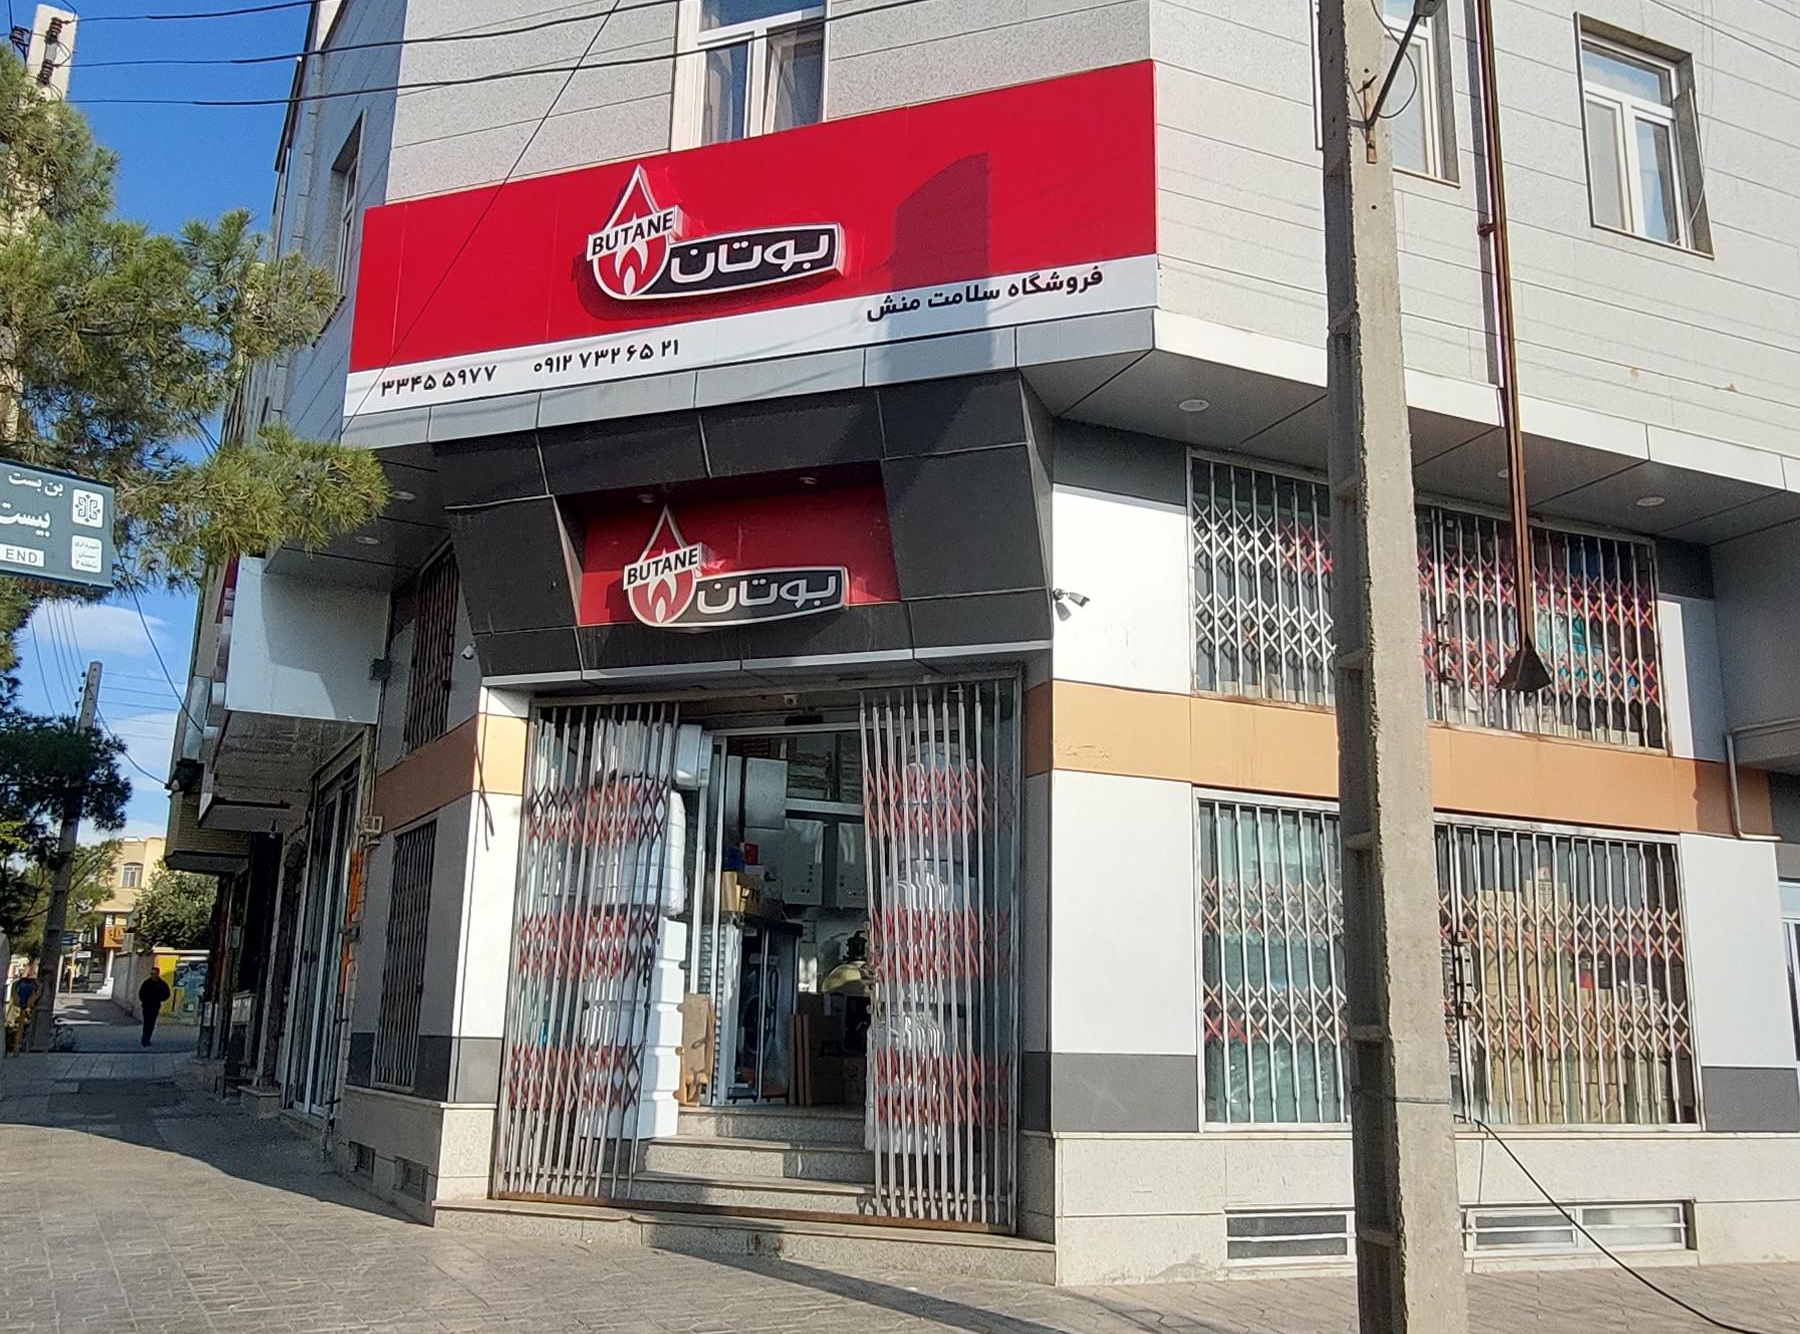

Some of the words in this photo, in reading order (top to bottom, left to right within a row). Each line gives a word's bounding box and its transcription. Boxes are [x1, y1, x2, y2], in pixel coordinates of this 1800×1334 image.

[591, 211, 674, 256] BUTANE
[669, 234, 830, 284] بوتان
[927, 283, 1001, 309] سلامت
[1007, 265, 1104, 298] فروشگاه
[866, 295, 921, 323] منش
[533, 354, 573, 373] ۰۹۱۲
[579, 347, 621, 369] ۷۳۲
[626, 343, 655, 362] ۶۵
[660, 339, 679, 357] ۲۱
[381, 375, 437, 397] ۳۳۴۵
[442, 364, 498, 387] ۵۹۷۷
[8, 472, 42, 492] بست
[44, 481, 64, 497] بن
[5, 548, 38, 564] END
[626, 547, 699, 586] BUTANE
[696, 575, 837, 614] بوتان
